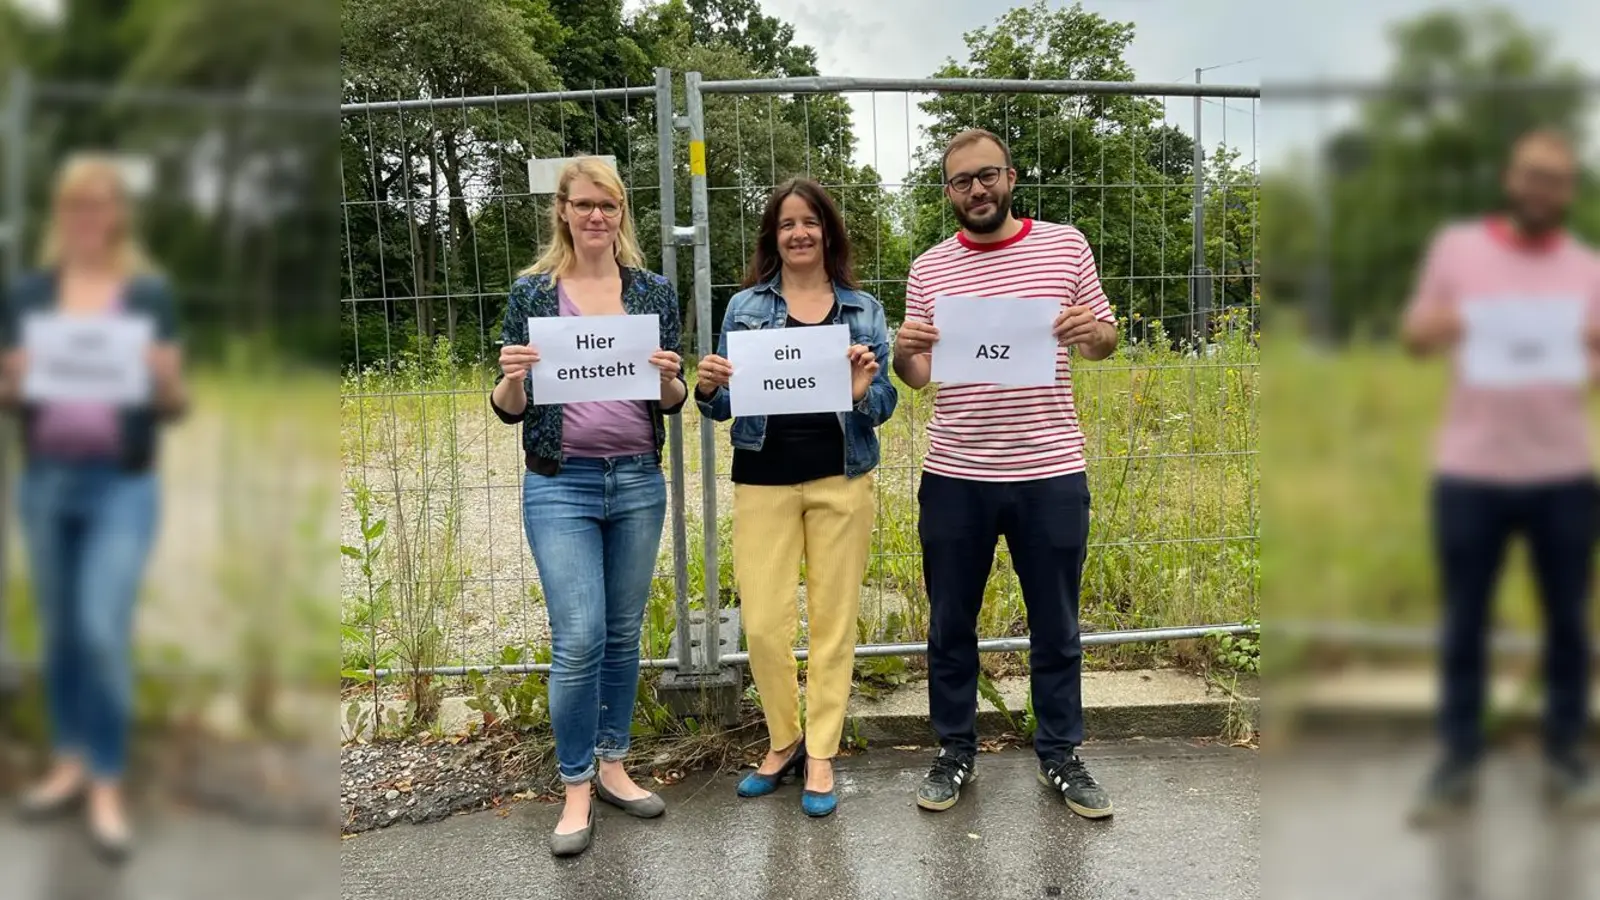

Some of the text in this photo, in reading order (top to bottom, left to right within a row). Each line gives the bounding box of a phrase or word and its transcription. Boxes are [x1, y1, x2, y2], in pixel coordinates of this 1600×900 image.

[577, 334, 615, 349] Hier
[775, 345, 800, 360] ein
[976, 345, 1010, 359] ASZ
[557, 362, 635, 380] entsteht
[764, 377, 816, 390] neues
